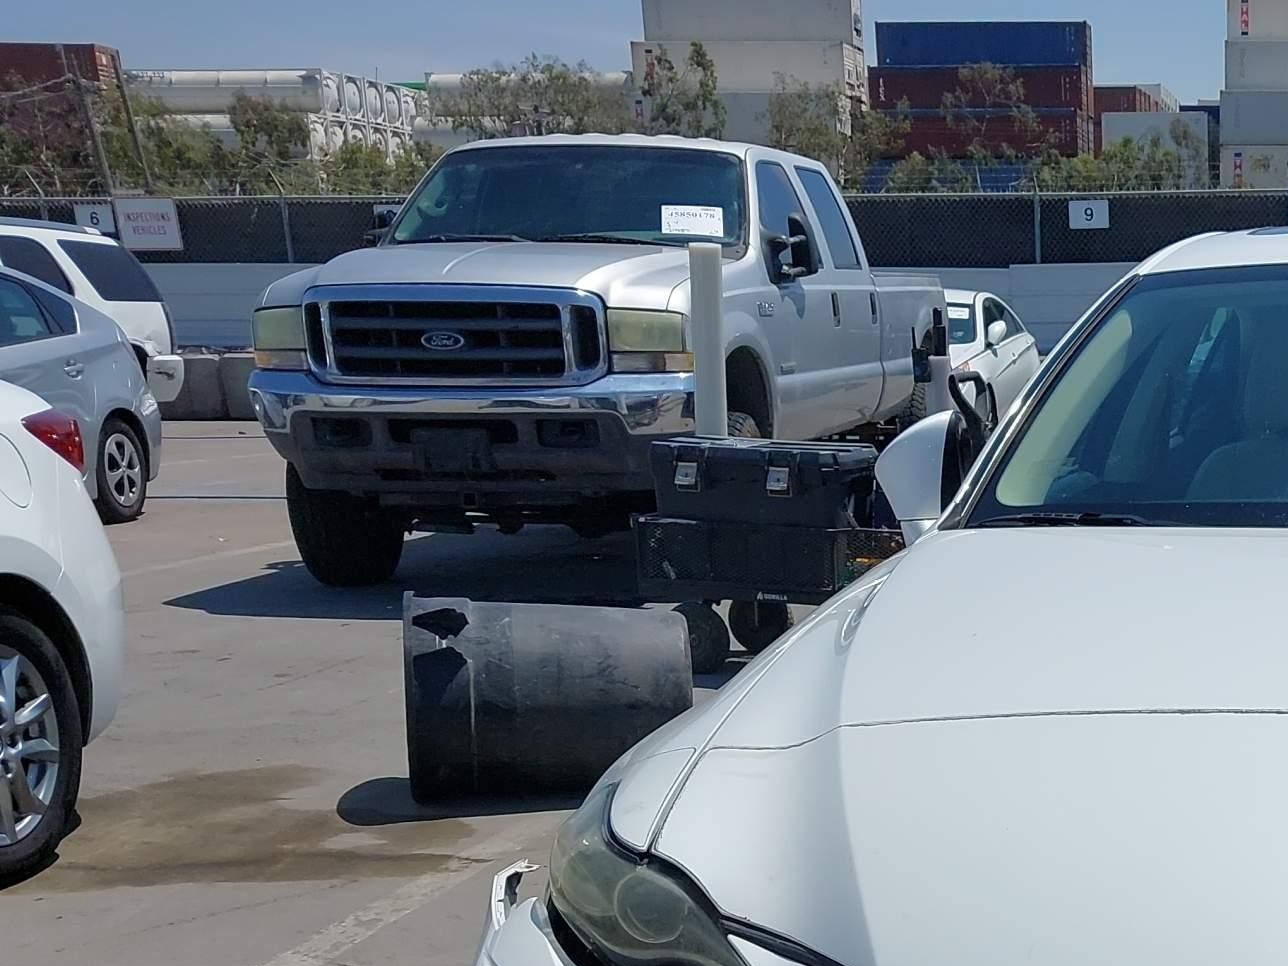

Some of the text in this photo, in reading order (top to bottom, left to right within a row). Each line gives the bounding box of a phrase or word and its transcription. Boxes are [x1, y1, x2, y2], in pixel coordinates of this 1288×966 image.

[89, 212, 100, 225] 6
[1084, 207, 1094, 221] 9
[431, 335, 455, 346] Ford
